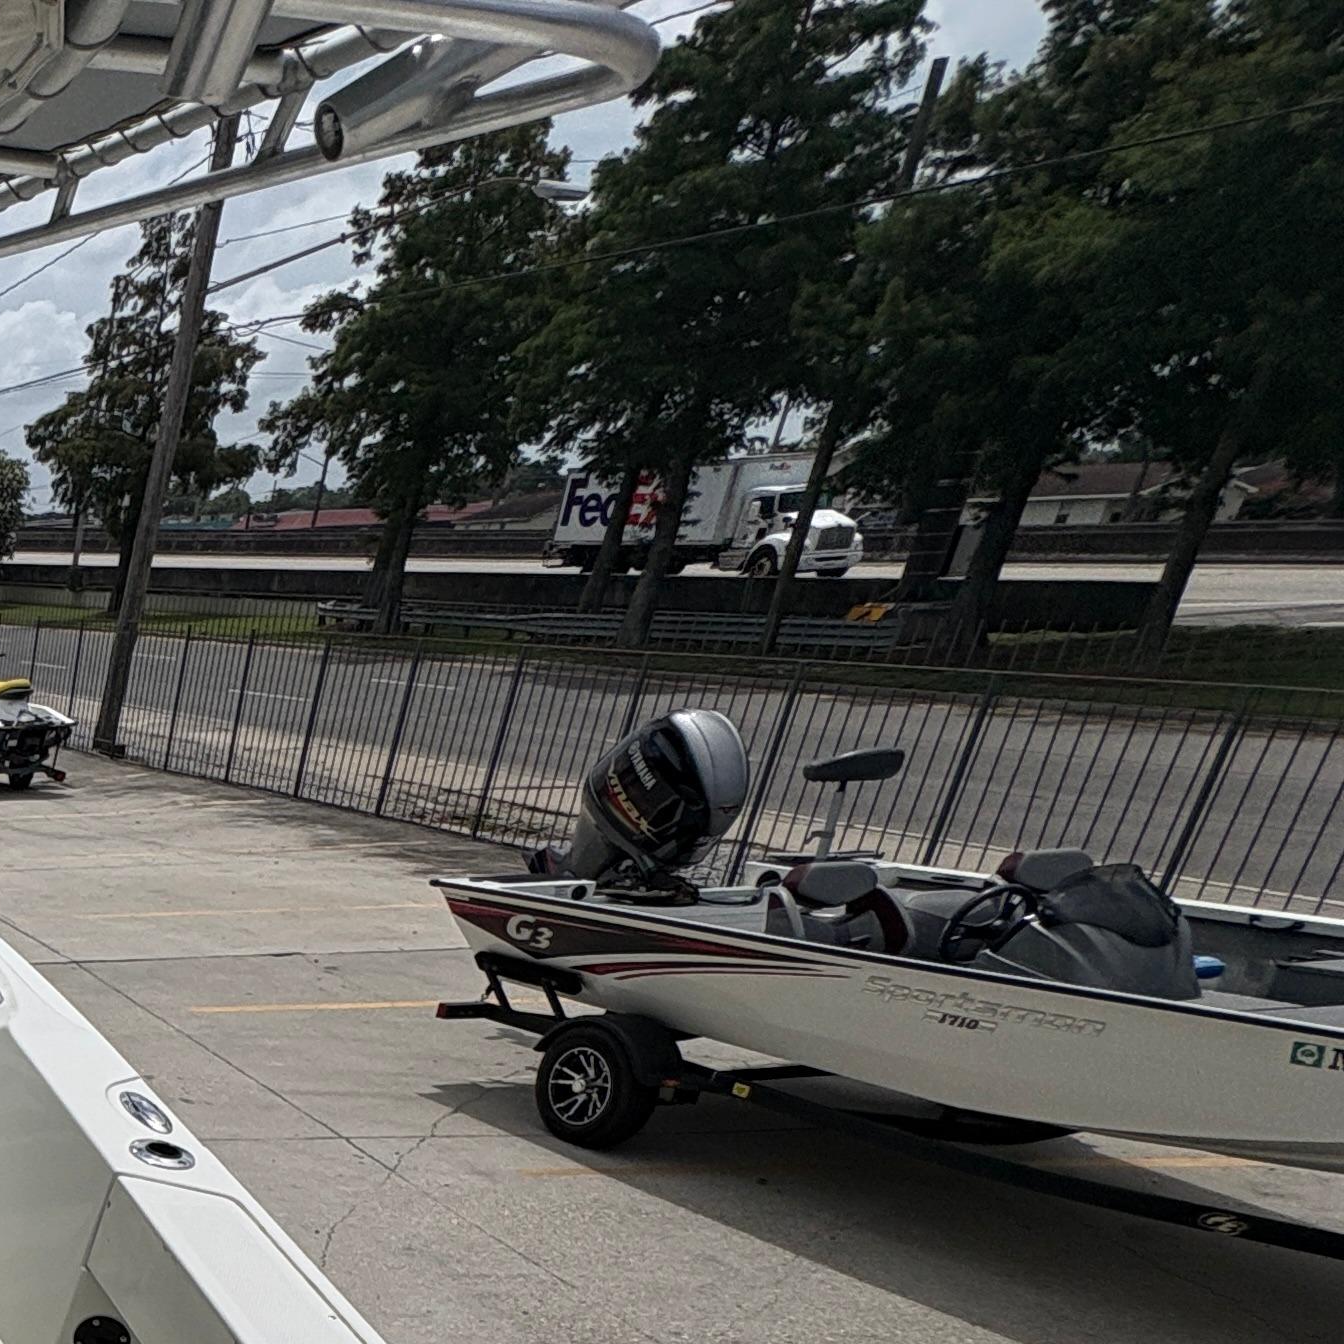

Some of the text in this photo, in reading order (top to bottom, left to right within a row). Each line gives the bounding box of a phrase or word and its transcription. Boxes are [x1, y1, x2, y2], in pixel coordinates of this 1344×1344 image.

[629, 750, 657, 791] YAMAHA
[507, 914, 554, 949] G3
[862, 975, 1107, 1037] Sportsman
[938, 1013, 981, 1031] 1710
